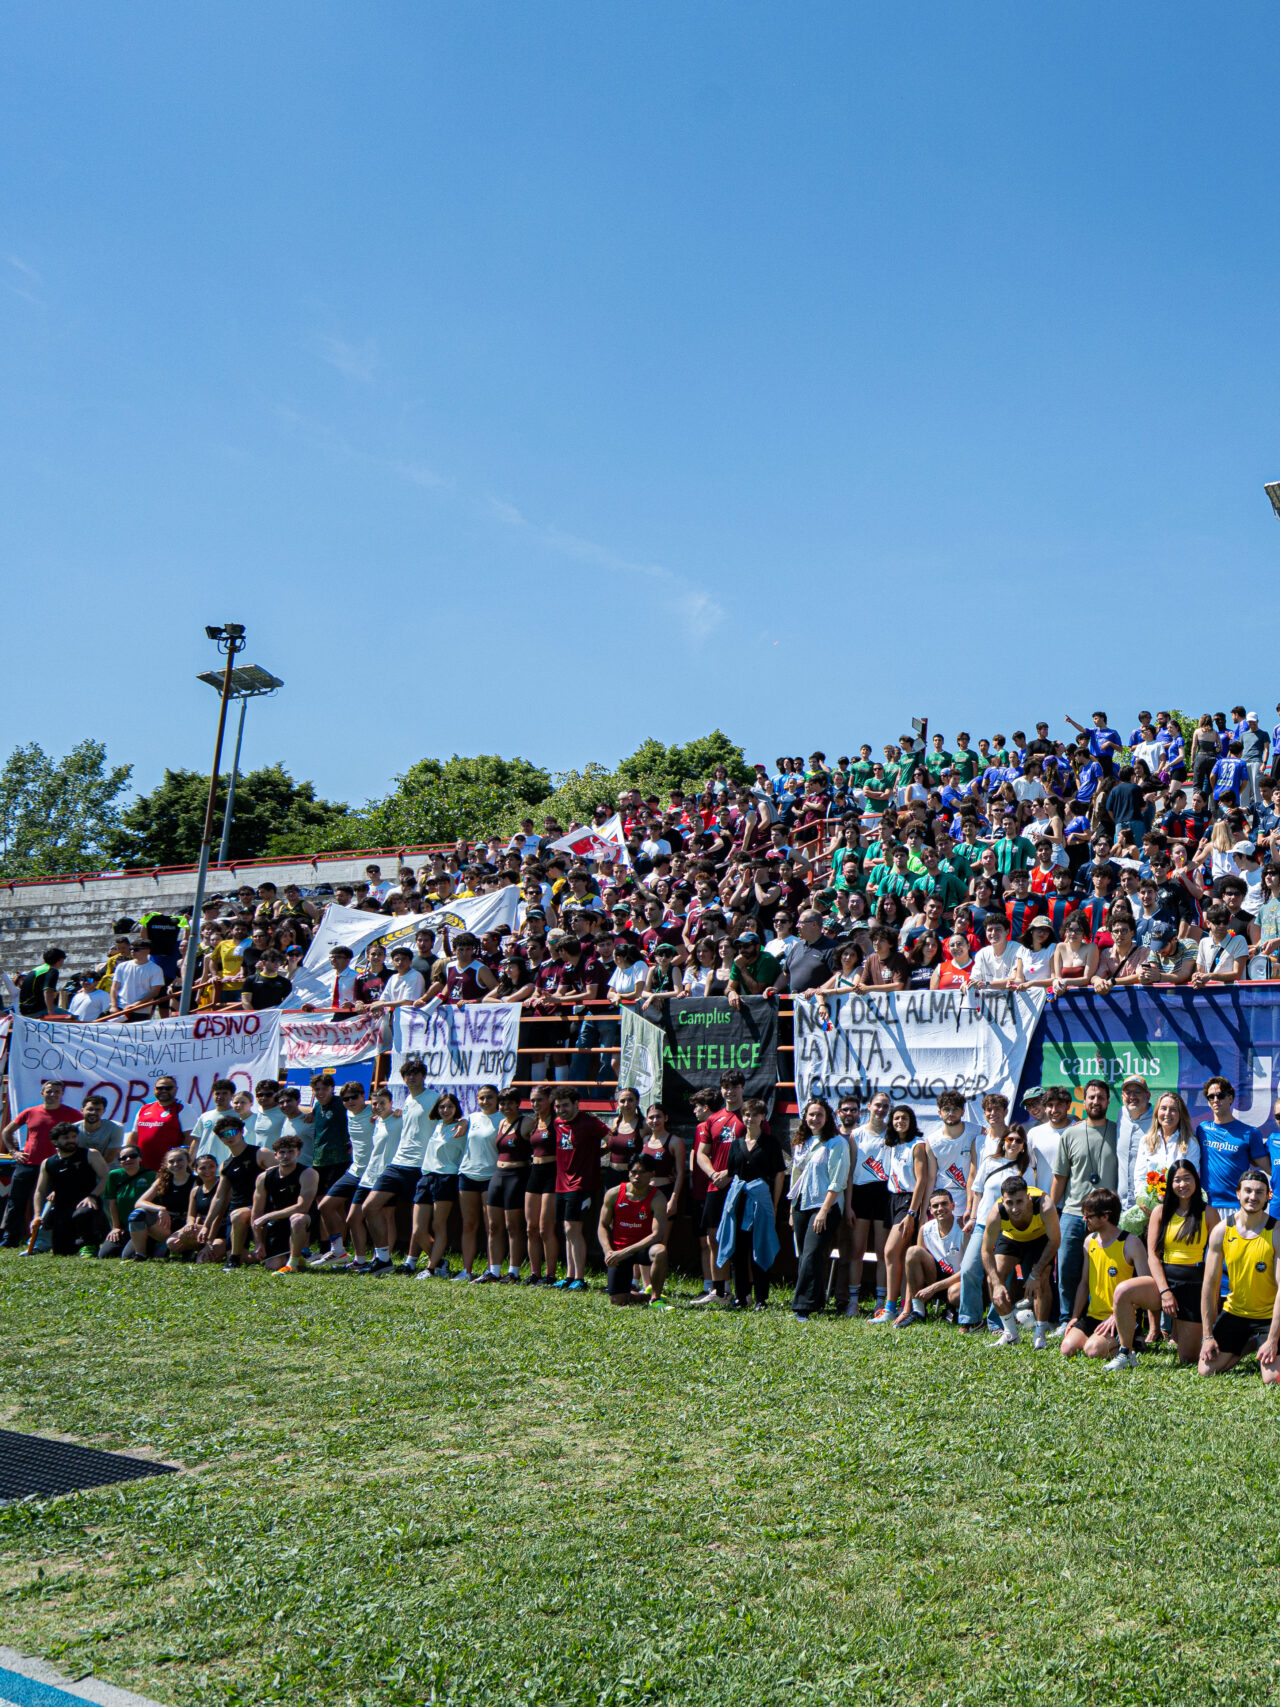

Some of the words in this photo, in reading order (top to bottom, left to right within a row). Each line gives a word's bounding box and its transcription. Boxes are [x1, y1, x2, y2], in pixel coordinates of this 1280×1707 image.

[951, 974, 965, 984] 23
[678, 1007, 731, 1029] Camplus
[906, 991, 958, 1025] ALMA
[193, 1013, 261, 1040] CASINO
[408, 1006, 513, 1048] FIRENZE
[21, 1047, 99, 1071] SONO
[211, 1031, 271, 1058] TRUPPE
[449, 1049, 473, 1078] UN
[477, 1049, 517, 1076] ALTRO
[663, 1044, 691, 1070] AN
[697, 1042, 762, 1070] FELICE
[800, 1037, 823, 1062] LA
[822, 1029, 892, 1073] VITA,
[147, 1069, 168, 1078] da
[1059, 1050, 1161, 1082] camplus
[889, 1074, 946, 1101] SOLO
[138, 1120, 164, 1129] camplus
[1203, 1138, 1239, 1153] camplus
